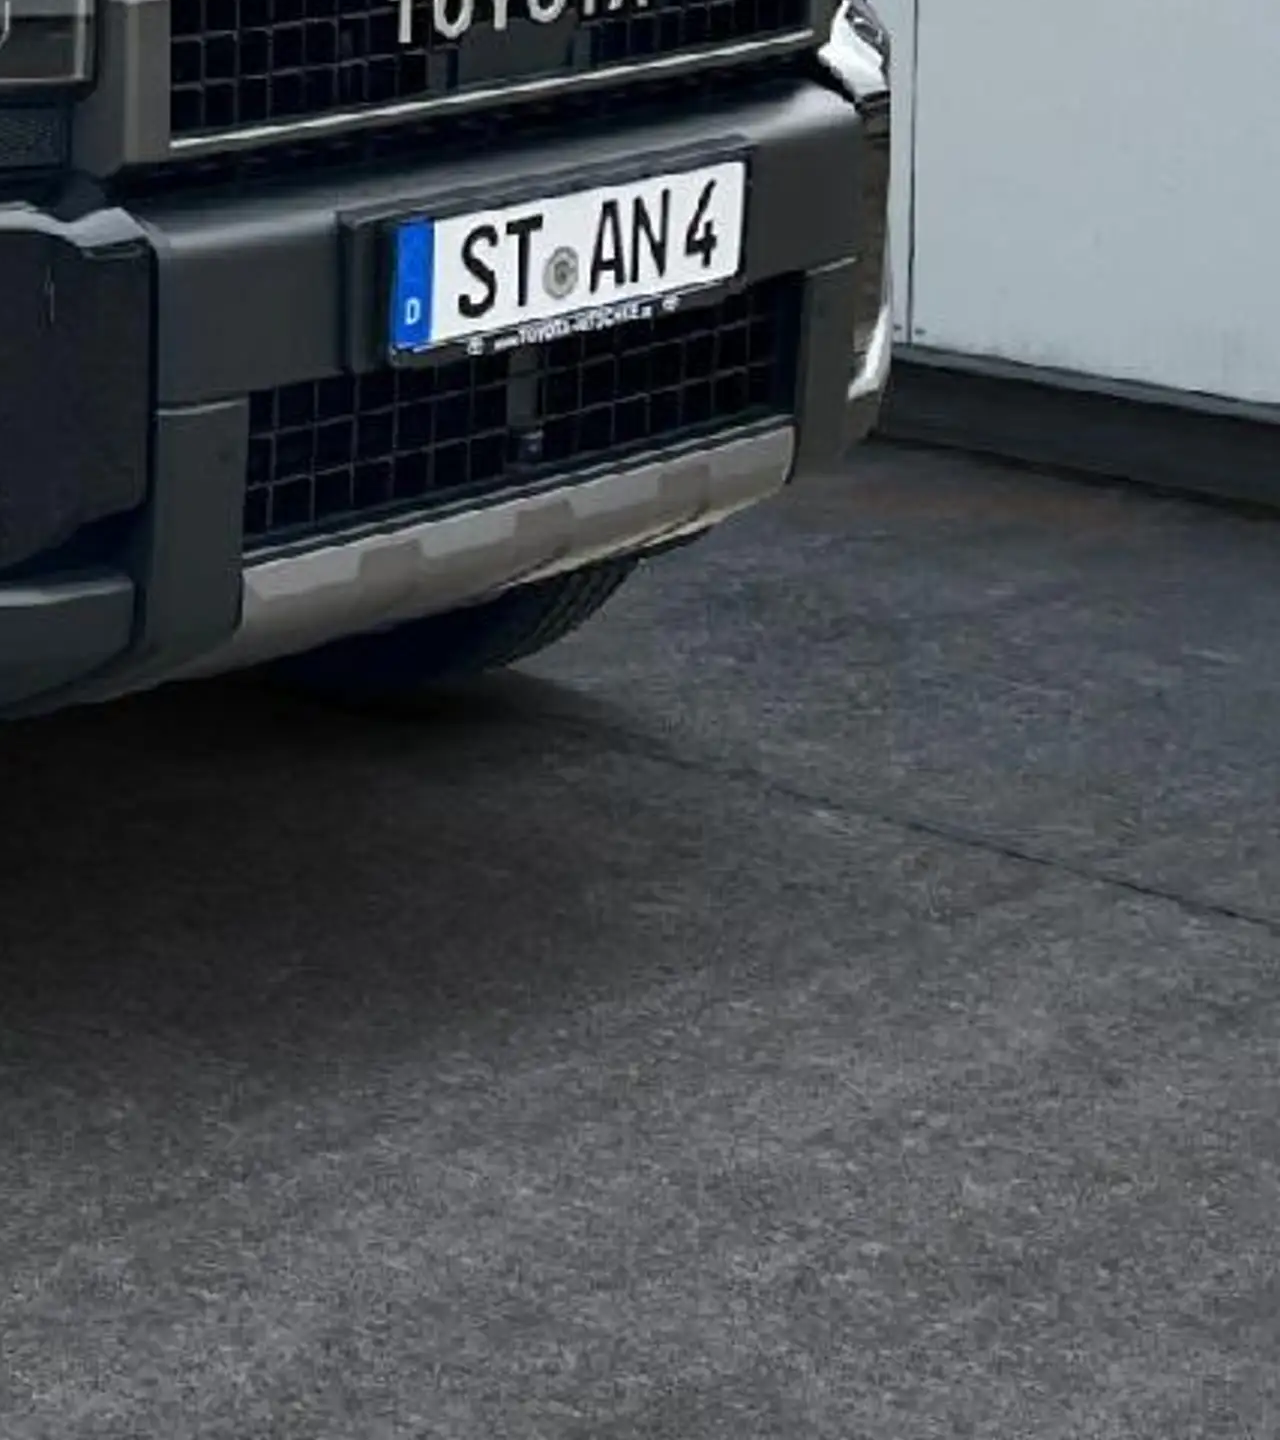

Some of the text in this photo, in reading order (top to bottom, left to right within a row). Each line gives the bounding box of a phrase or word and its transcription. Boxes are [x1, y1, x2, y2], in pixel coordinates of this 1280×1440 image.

[457, 179, 717, 319] ST AN 4
[404, 297, 420, 326] D
